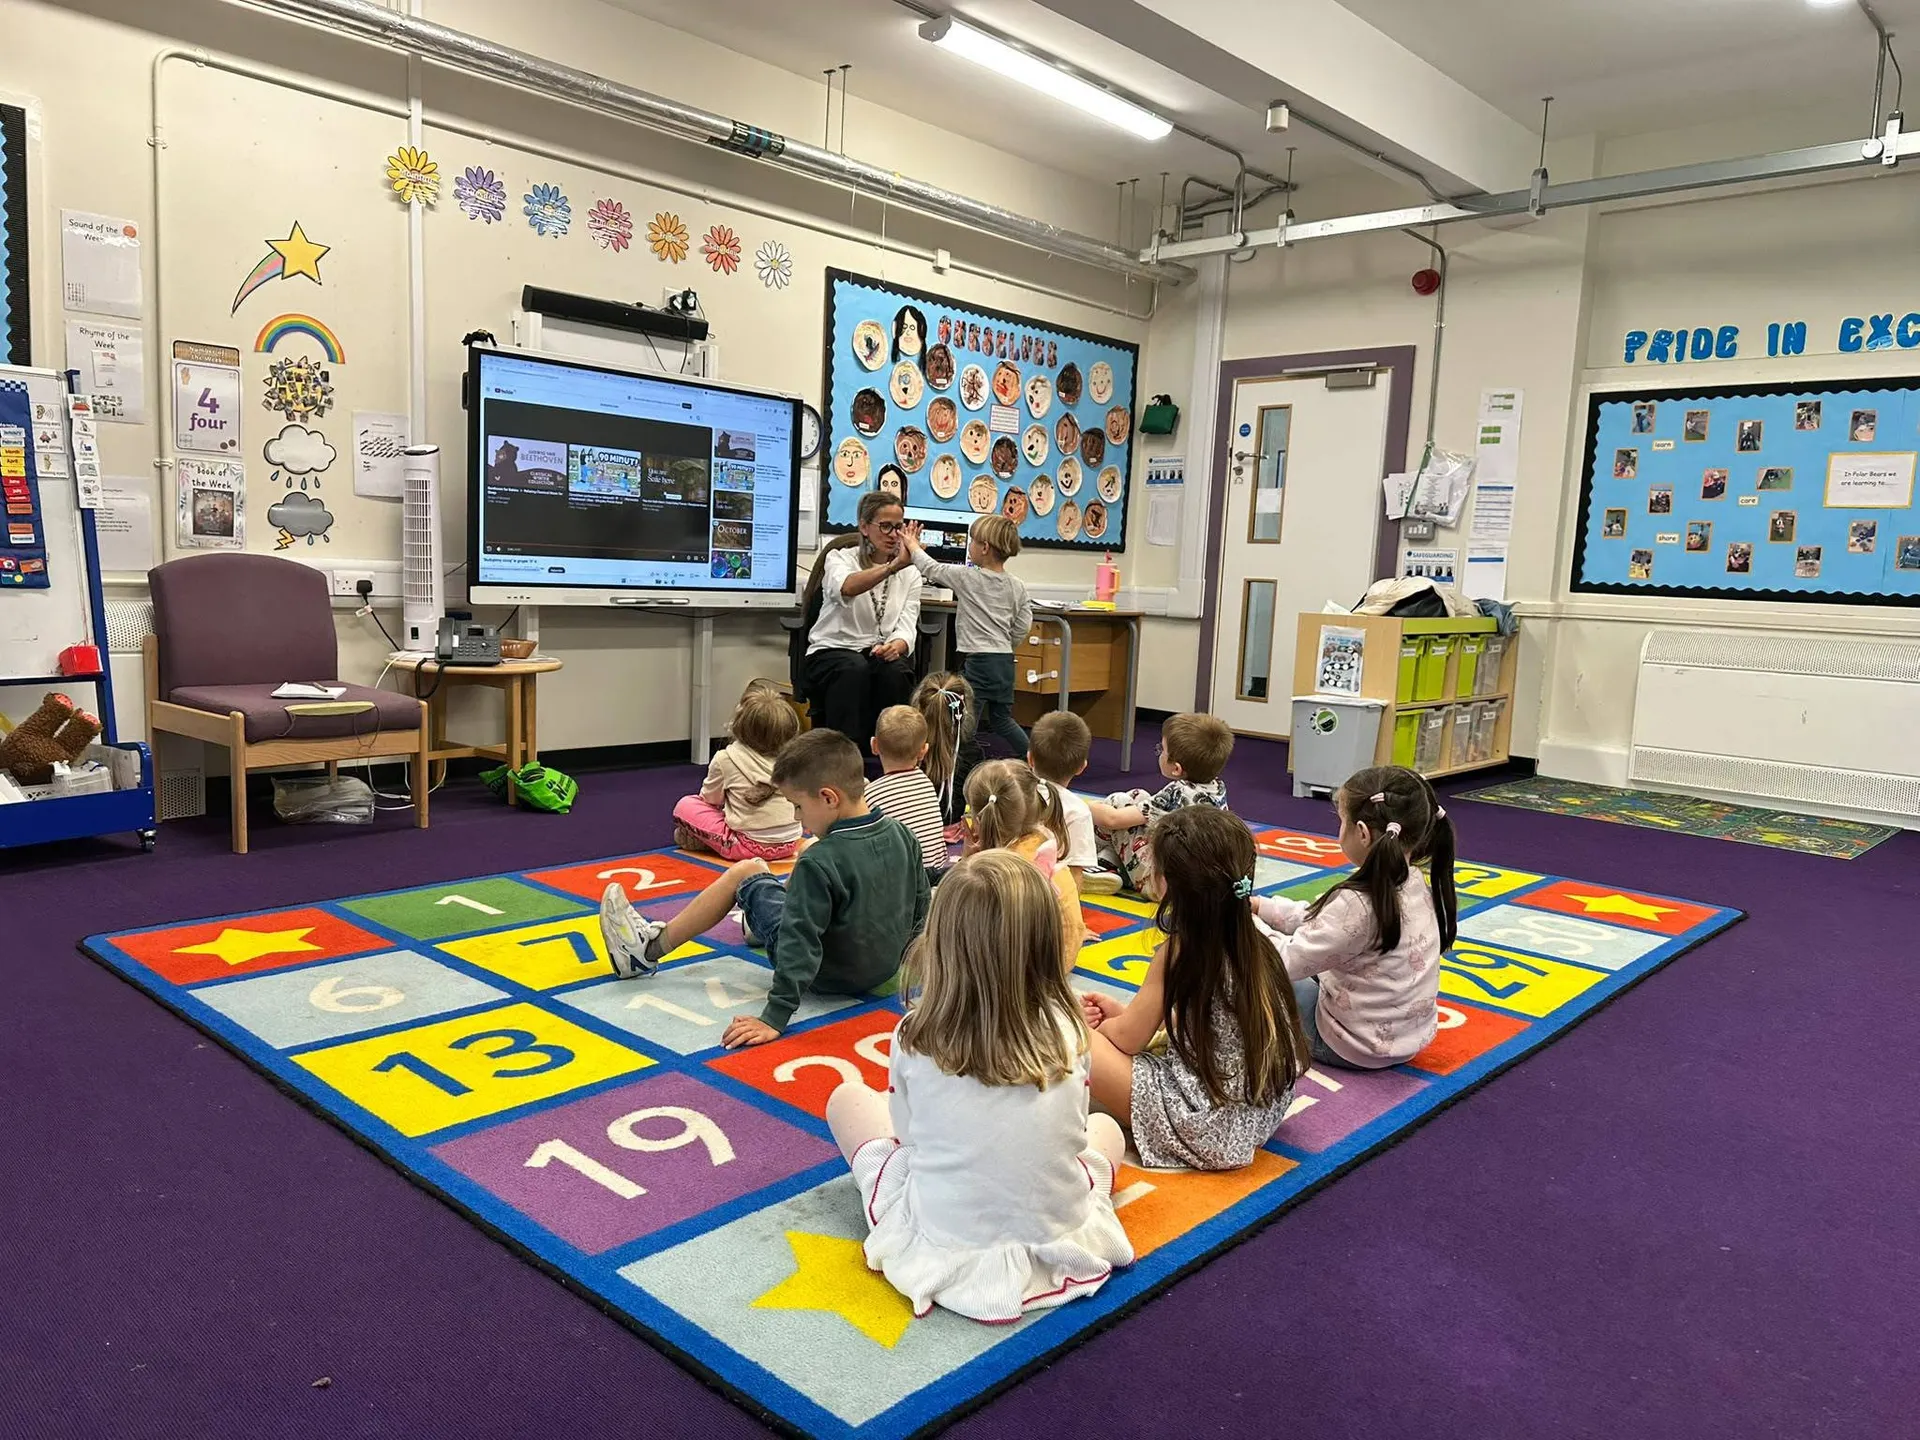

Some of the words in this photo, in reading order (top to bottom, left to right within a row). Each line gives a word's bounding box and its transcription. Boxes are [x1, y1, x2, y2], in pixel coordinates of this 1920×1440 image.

[69, 219, 93, 230] Sound
[96, 225, 104, 233] of
[80, 327, 105, 338] Rhyme
[108, 332, 115, 340] of
[938, 315, 1058, 369] OURSELVES
[1623, 325, 1739, 363] PRIDE
[1766, 321, 1807, 357] IN
[1838, 312, 1920, 352] EXC
[95, 340, 115, 349] Week
[198, 388, 219, 413] 4
[189, 413, 227, 431] four
[520, 453, 563, 465] BEETHOVEN
[599, 453, 609, 462] 90
[198, 466, 216, 476] Book
[662, 476, 675, 485] here
[209, 480, 232, 489] Week
[597, 868, 686, 891] 2
[435, 895, 506, 915] 1
[1490, 915, 1617, 956] 30
[517, 931, 599, 963] 7
[309, 977, 406, 1013] 6
[371, 1028, 576, 1097] 13
[524, 1106, 736, 1200] 19
